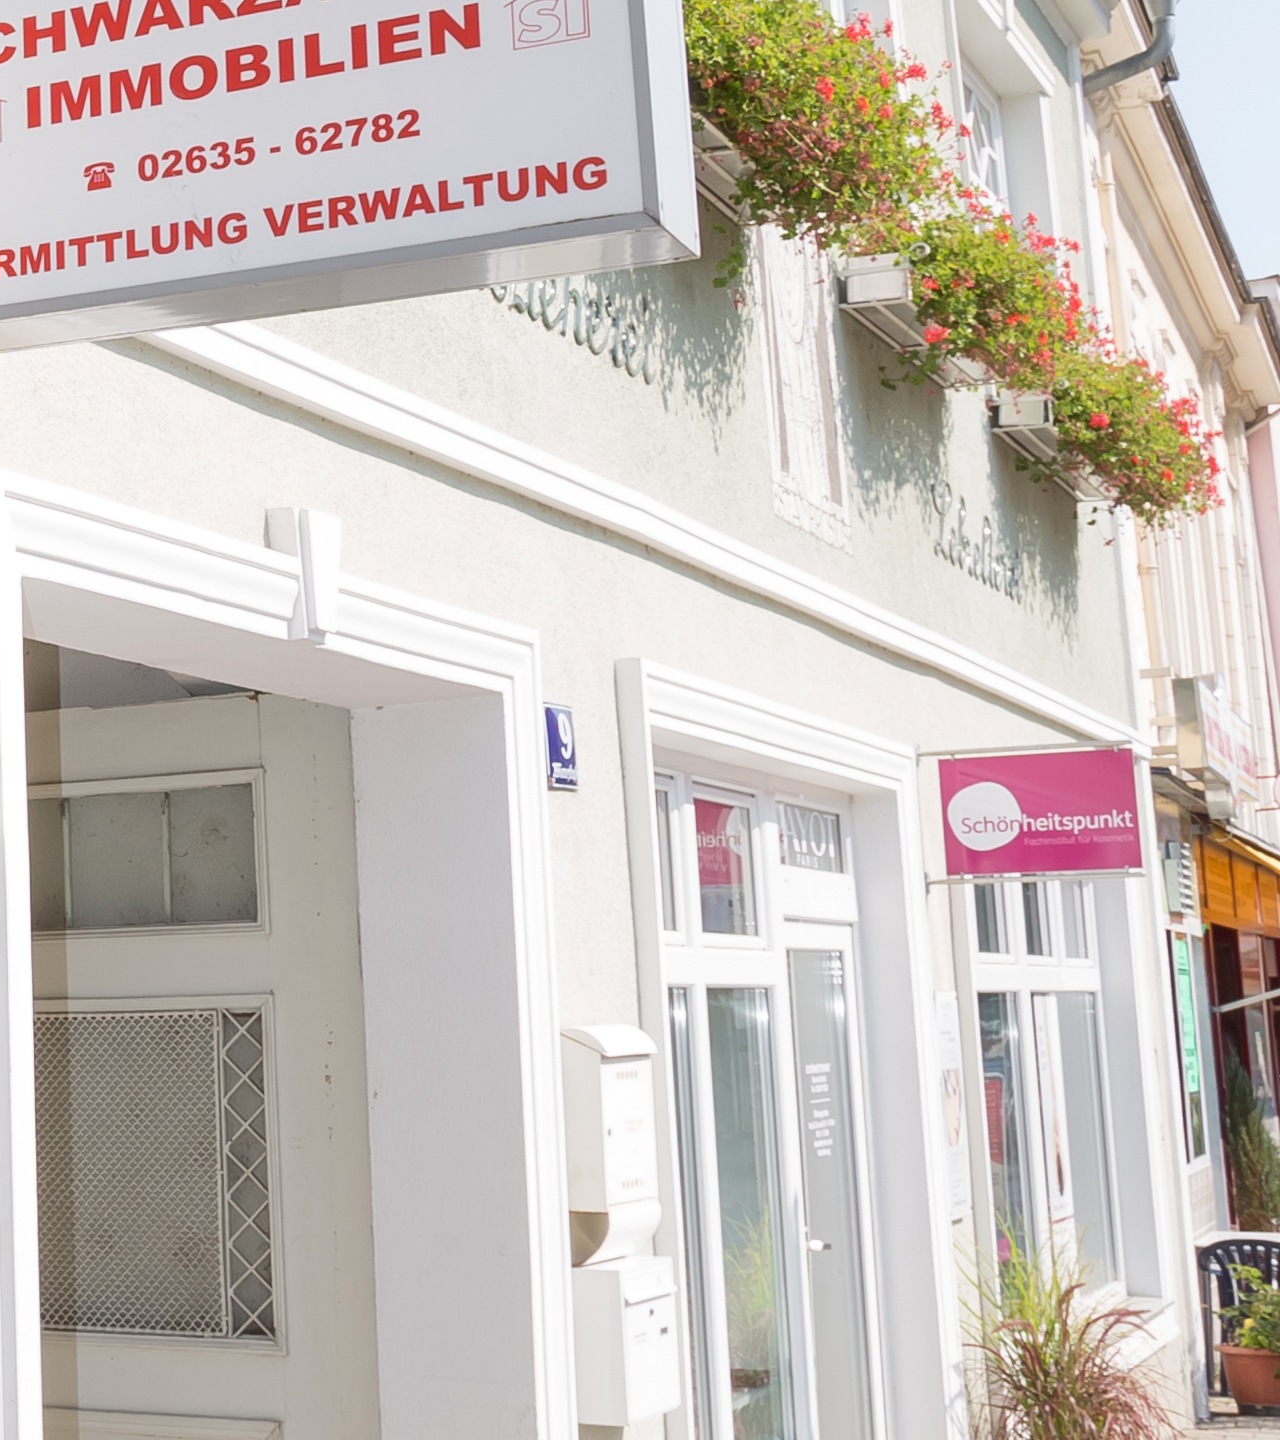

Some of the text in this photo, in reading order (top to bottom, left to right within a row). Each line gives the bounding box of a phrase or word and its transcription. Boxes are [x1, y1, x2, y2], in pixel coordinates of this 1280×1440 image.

[27, 4, 480, 128] IMMOBILIEN
[138, 137, 255, 181] 02635
[295, 110, 420, 155] 62782
[264, 157, 607, 236] VERWALTUNG
[557, 712, 573, 760] 9
[781, 804, 837, 858] AYOT
[961, 808, 1135, 835] Schönheitspunkt
